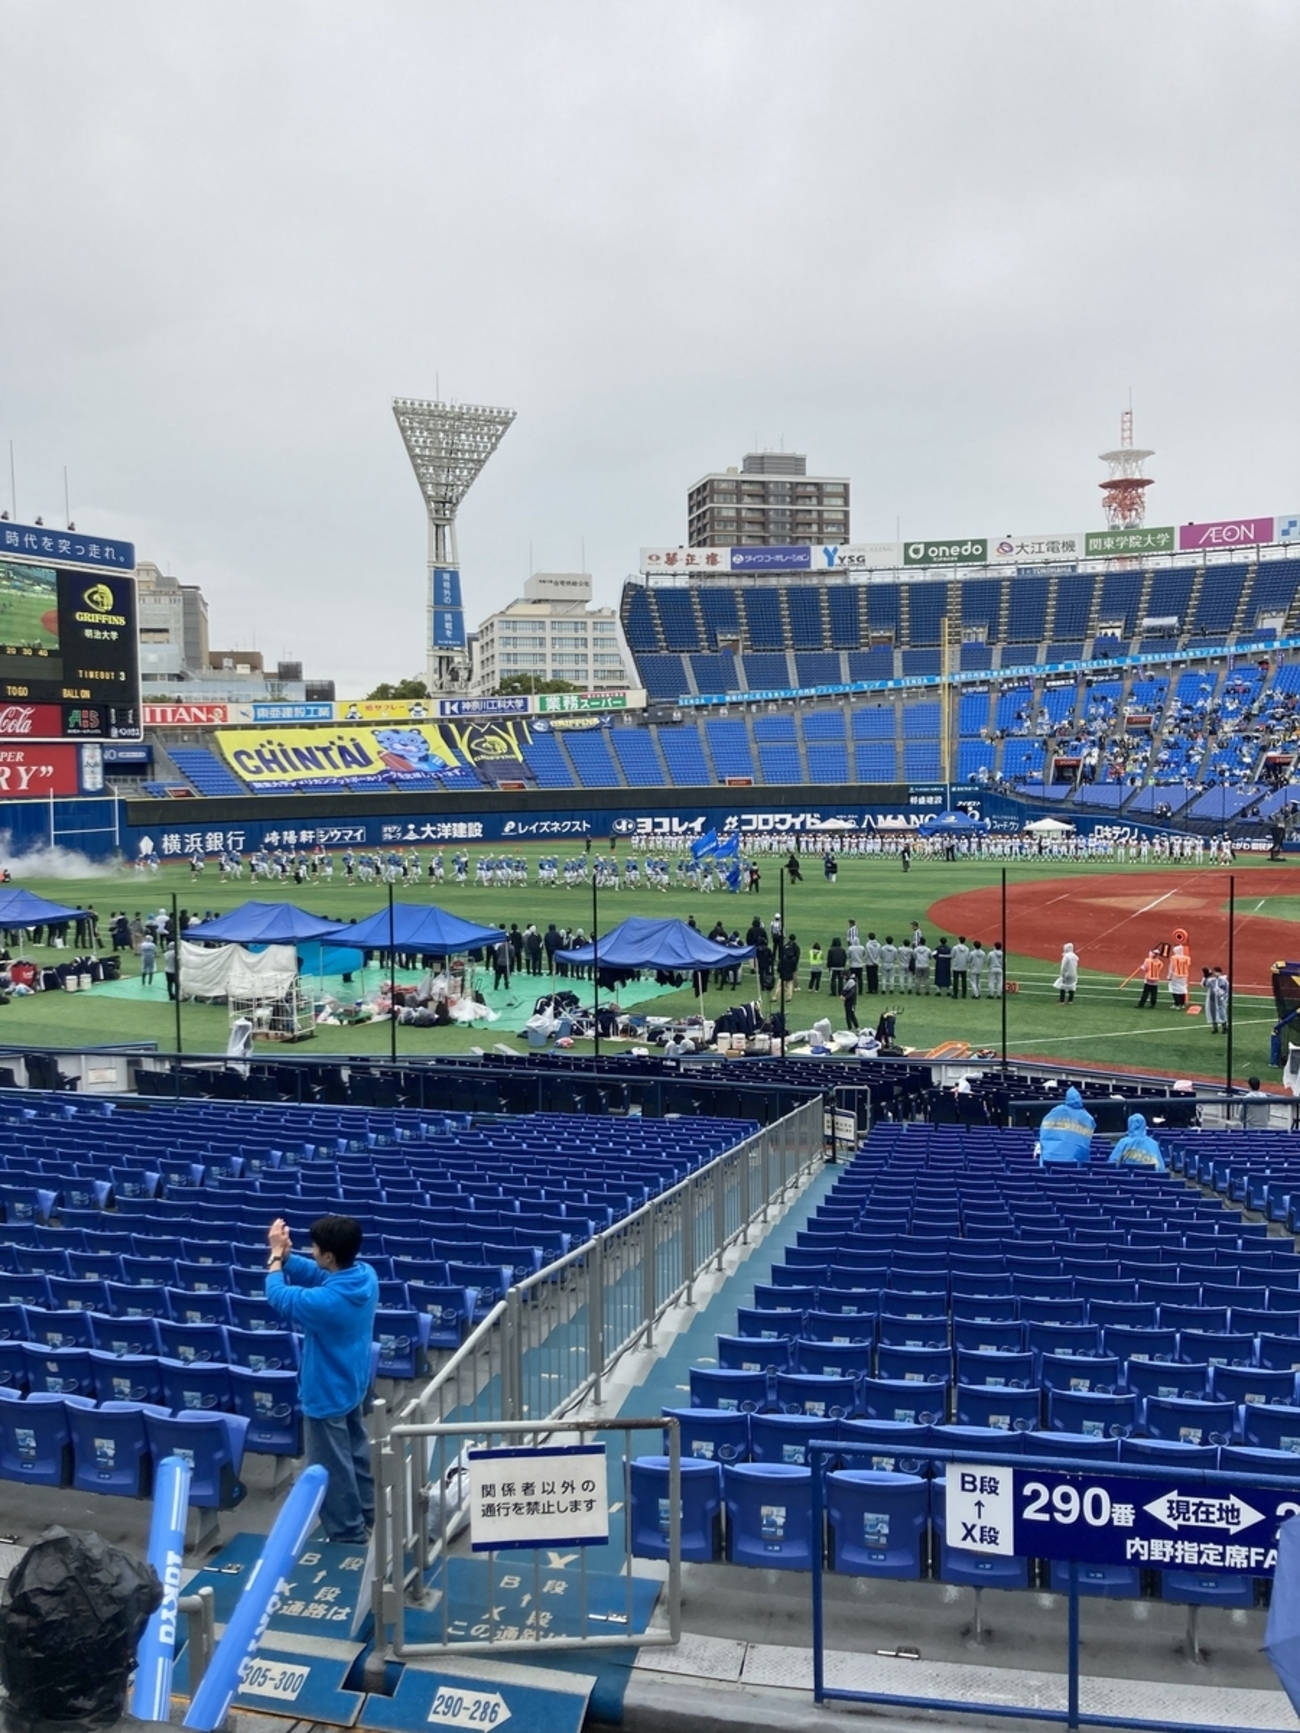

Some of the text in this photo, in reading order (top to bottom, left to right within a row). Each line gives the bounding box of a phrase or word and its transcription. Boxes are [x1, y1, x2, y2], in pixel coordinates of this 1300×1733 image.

[5, 530, 125, 562] 時代を突っ走れ。
[928, 542, 983, 557] onedo
[1089, 533, 1170, 550] 関東学院大学
[1015, 544, 1076, 559] 大江電機
[76, 612, 126, 626] GRIFFINS
[84, 629, 119, 641] 明治大学
[22, 648, 33, 656] 30
[38, 649, 49, 657] 40
[78, 669, 126, 681] TIMEOUT 3
[461, 702, 524, 712] 神奈川工科大学
[545, 697, 623, 711] 業務スーパー
[257, 707, 329, 720] 東亜建設工業
[234, 740, 375, 776] CHINTAI
[517, 820, 591, 834] レイズネクスト
[636, 817, 707, 832] ヨコレイ
[741, 813, 822, 830] コロワイド
[264, 830, 315, 846] 崎陽軒
[318, 828, 365, 843] シウマイ
[421, 822, 483, 839] 大洋建設
[162, 831, 246, 855] 横浜銀行
[481, 1479, 596, 1498] 関係者以外の
[960, 1473, 999, 1496] B段
[481, 1498, 597, 1518] 通行を禁止します
[1166, 1499, 1241, 1526] 現在地
[960, 1522, 999, 1546] X段
[432, 1694, 500, 1723] 290-286
